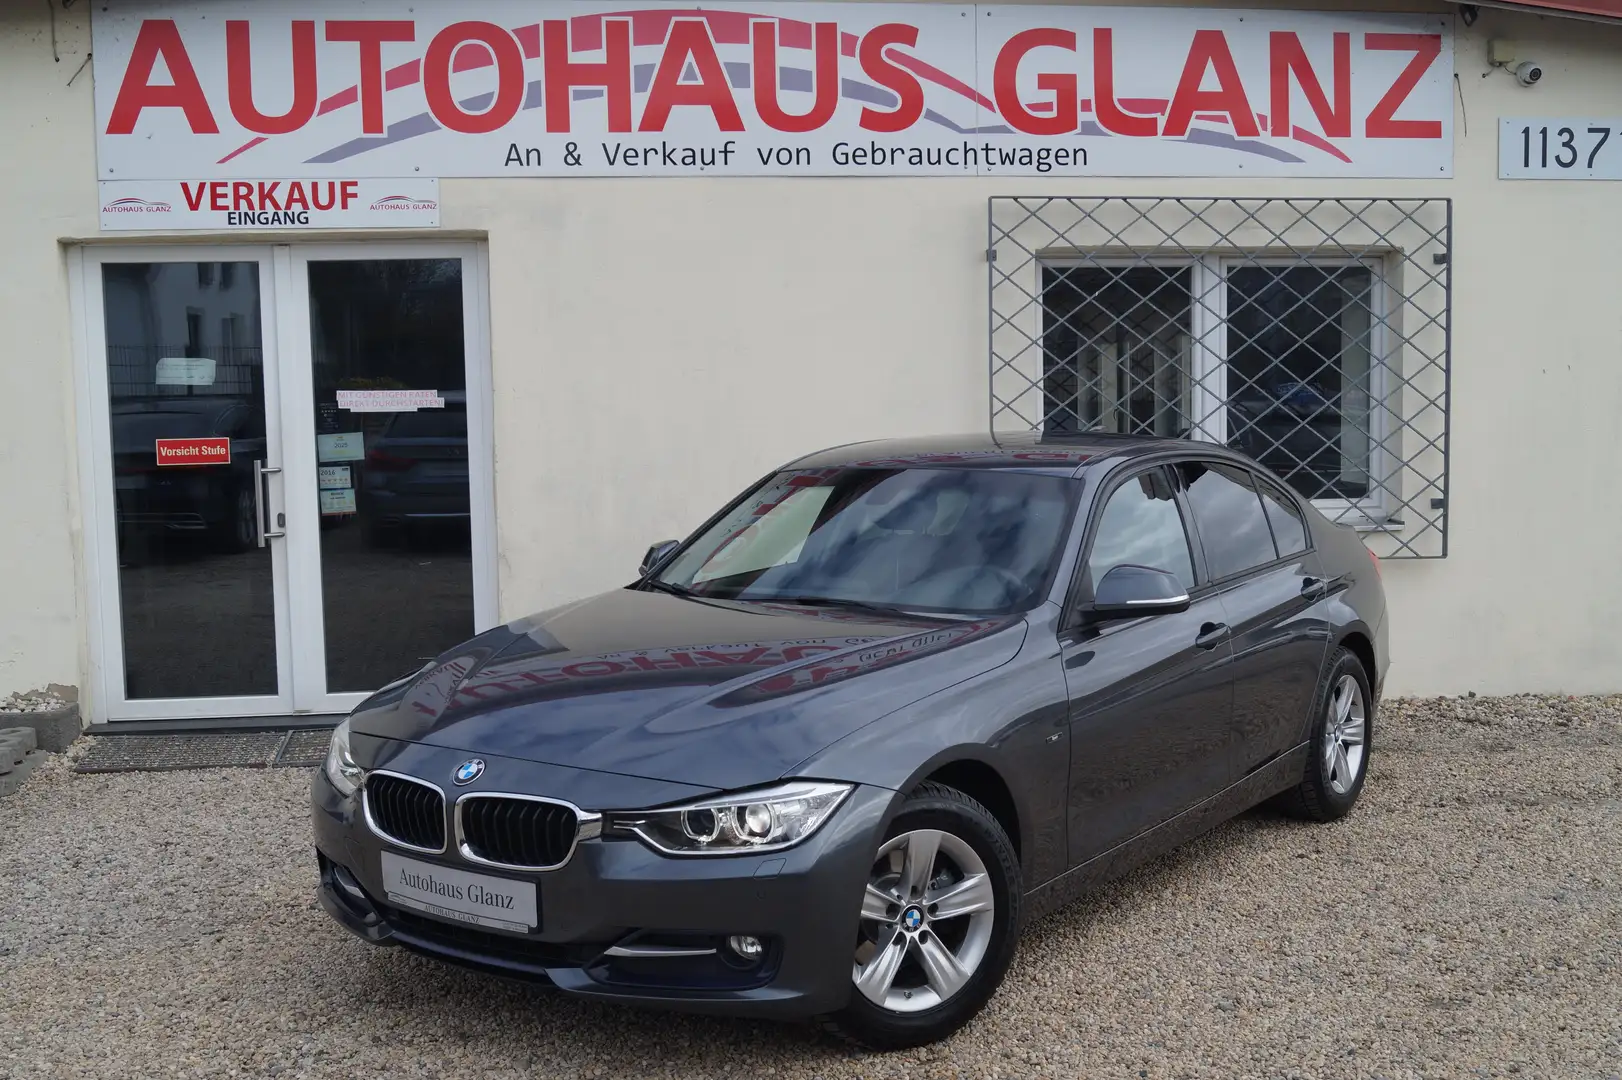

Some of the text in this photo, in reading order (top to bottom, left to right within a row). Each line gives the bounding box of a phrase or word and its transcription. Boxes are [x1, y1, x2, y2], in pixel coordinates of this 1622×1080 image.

[106, 18, 1442, 139] AUTOHAUS GLANZ
[504, 140, 1088, 173] An & Verkauf von Gebrauchtwagen
[1521, 126, 1622, 169] 1137
[180, 181, 358, 212] VERKAUF
[227, 211, 309, 225] EINGANG
[160, 445, 227, 457] Vorsicht Stufe
[400, 867, 515, 911] Autohaus Glanz
[424, 904, 480, 924] AUTOHAUS GLANZ
